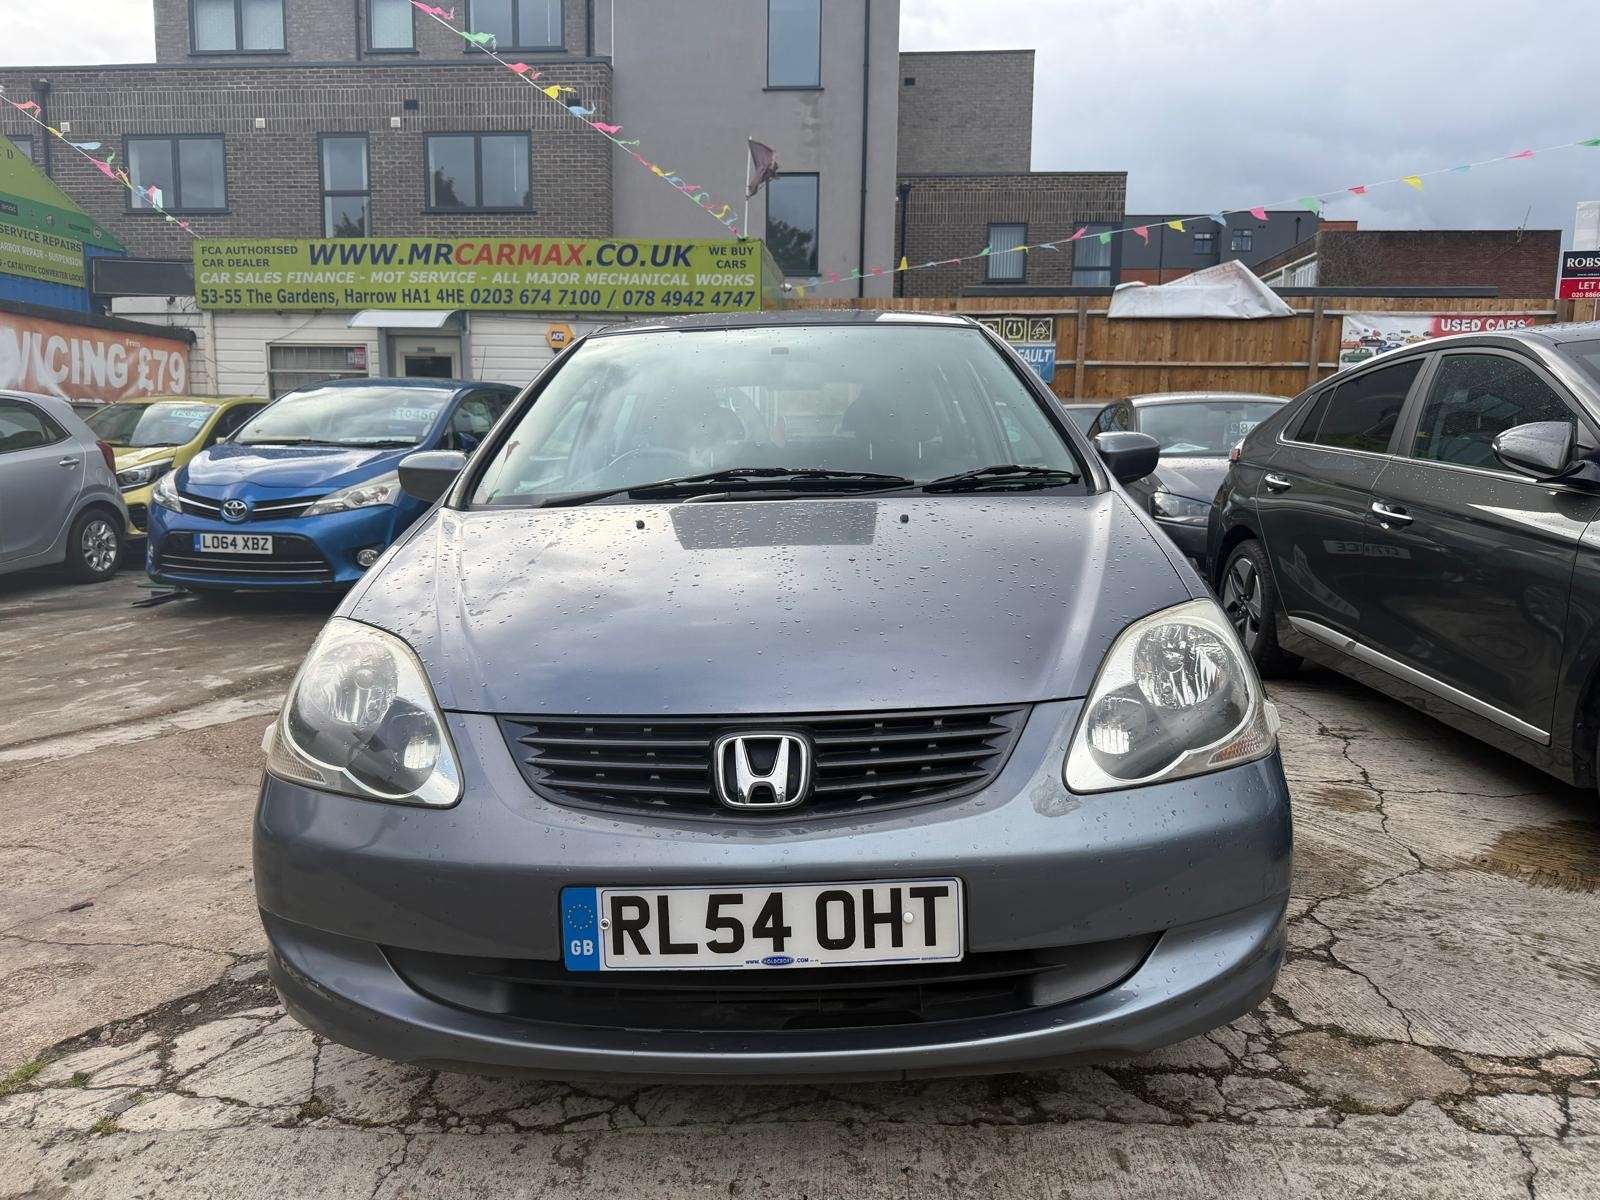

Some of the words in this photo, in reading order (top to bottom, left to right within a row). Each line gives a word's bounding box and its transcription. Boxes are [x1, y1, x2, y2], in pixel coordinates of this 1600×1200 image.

[0, 224, 40, 243] SERVICE
[42, 235, 82, 252] REPAIRS
[201, 246, 222, 255] FCA
[225, 246, 298, 255] AUTHORISED
[309, 243, 695, 268] WWW.MRCARMAX.CO.UK
[708, 246, 728, 256] WE
[731, 246, 754, 256] BUY
[202, 258, 224, 267] CAR
[228, 258, 270, 267] DEALER
[716, 259, 747, 269] CARS
[200, 272, 231, 284] CAR
[235, 272, 282, 284] SALES
[287, 272, 354, 284] FINANCE
[370, 272, 402, 284] MOT
[408, 272, 476, 284] SERVICE
[492, 272, 521, 284] ALL
[526, 272, 580, 285] MAJOR
[585, 273, 690, 286] MECHANICAL
[695, 274, 755, 286] WORKS
[1578, 281, 1597, 290] LET
[201, 288, 243, 304] 53-55
[246, 288, 272, 304] The
[277, 288, 340, 306] Gardens,
[345, 288, 397, 304] Harrow
[402, 288, 431, 304] HA1
[436, 288, 465, 304] 4HE
[470, 288, 513, 305] 0203
[519, 288, 551, 305] 674
[559, 289, 600, 306] 7100
[623, 290, 655, 306] 078
[660, 290, 705, 307] 4942
[711, 290, 756, 307] 4747
[1441, 318, 1481, 331] USED
[1485, 318, 1527, 331] CARS
[138, 347, 186, 394] £79
[202, 535, 238, 550] LO64
[242, 537, 269, 551] XBZ
[610, 891, 792, 955] RL54
[815, 885, 949, 950] OHT
[571, 940, 594, 956] GB
